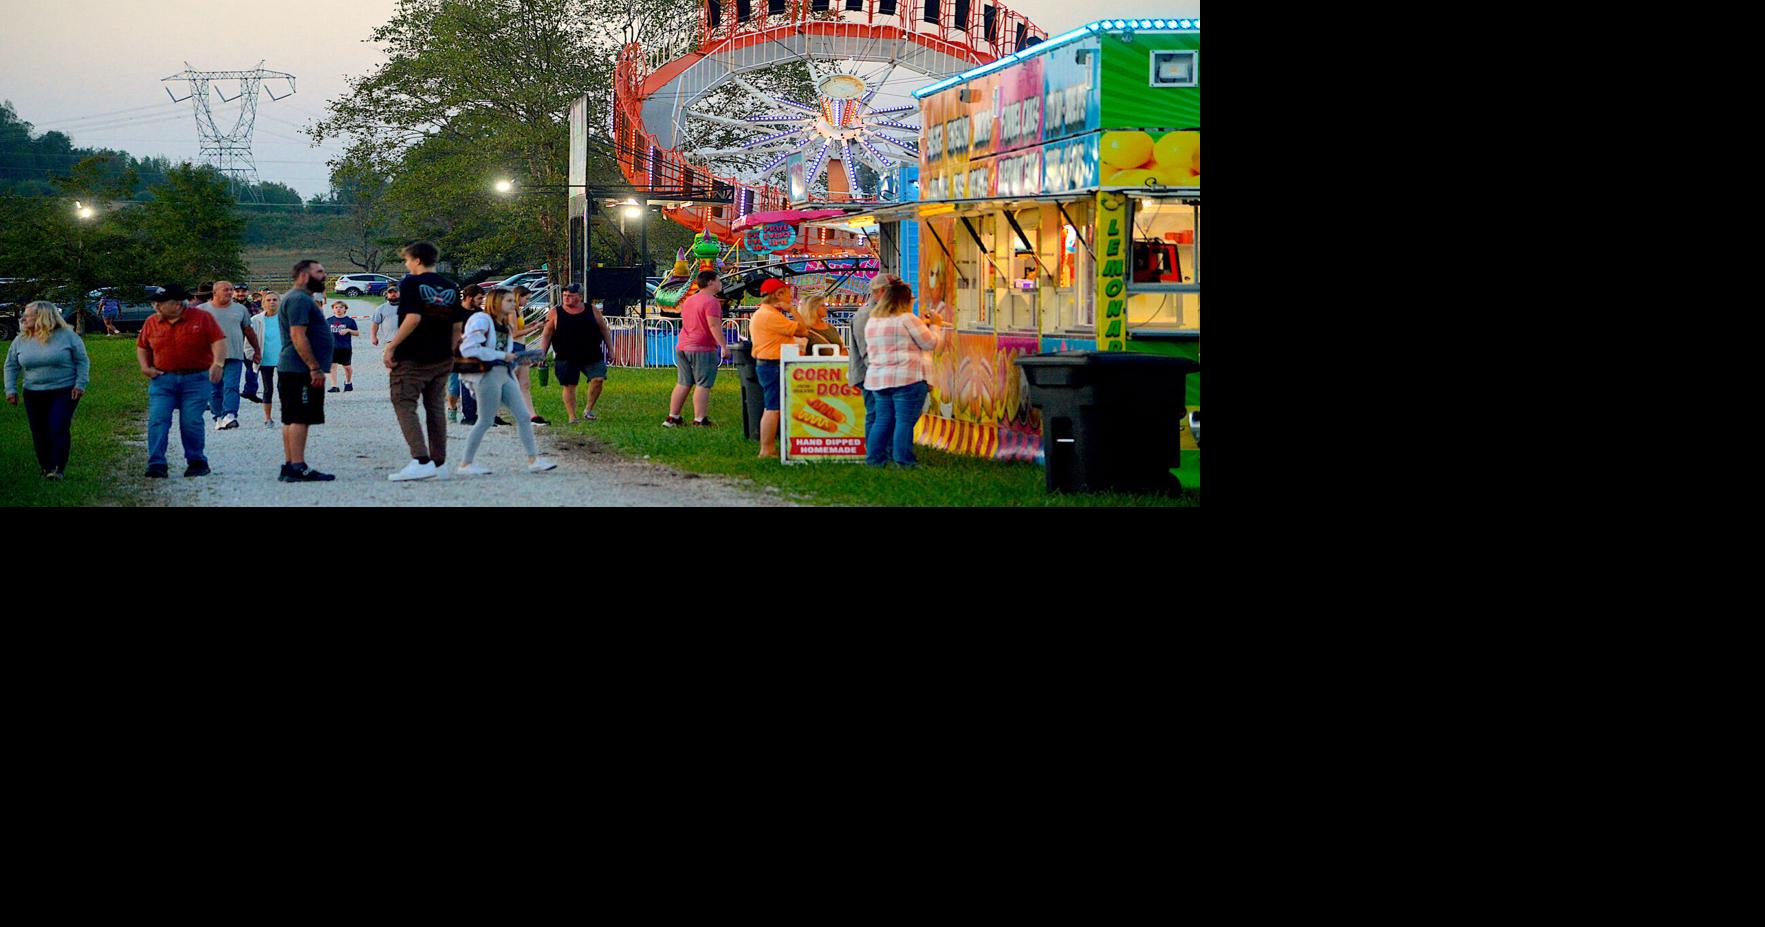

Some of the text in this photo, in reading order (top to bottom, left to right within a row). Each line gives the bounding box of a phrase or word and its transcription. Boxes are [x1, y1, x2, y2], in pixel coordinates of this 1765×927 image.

[792, 368, 841, 382] CORN
[816, 383, 862, 397] DOGS
[796, 438, 861, 446] HAND DIPPED
[800, 446, 857, 454] HOMEMADE
